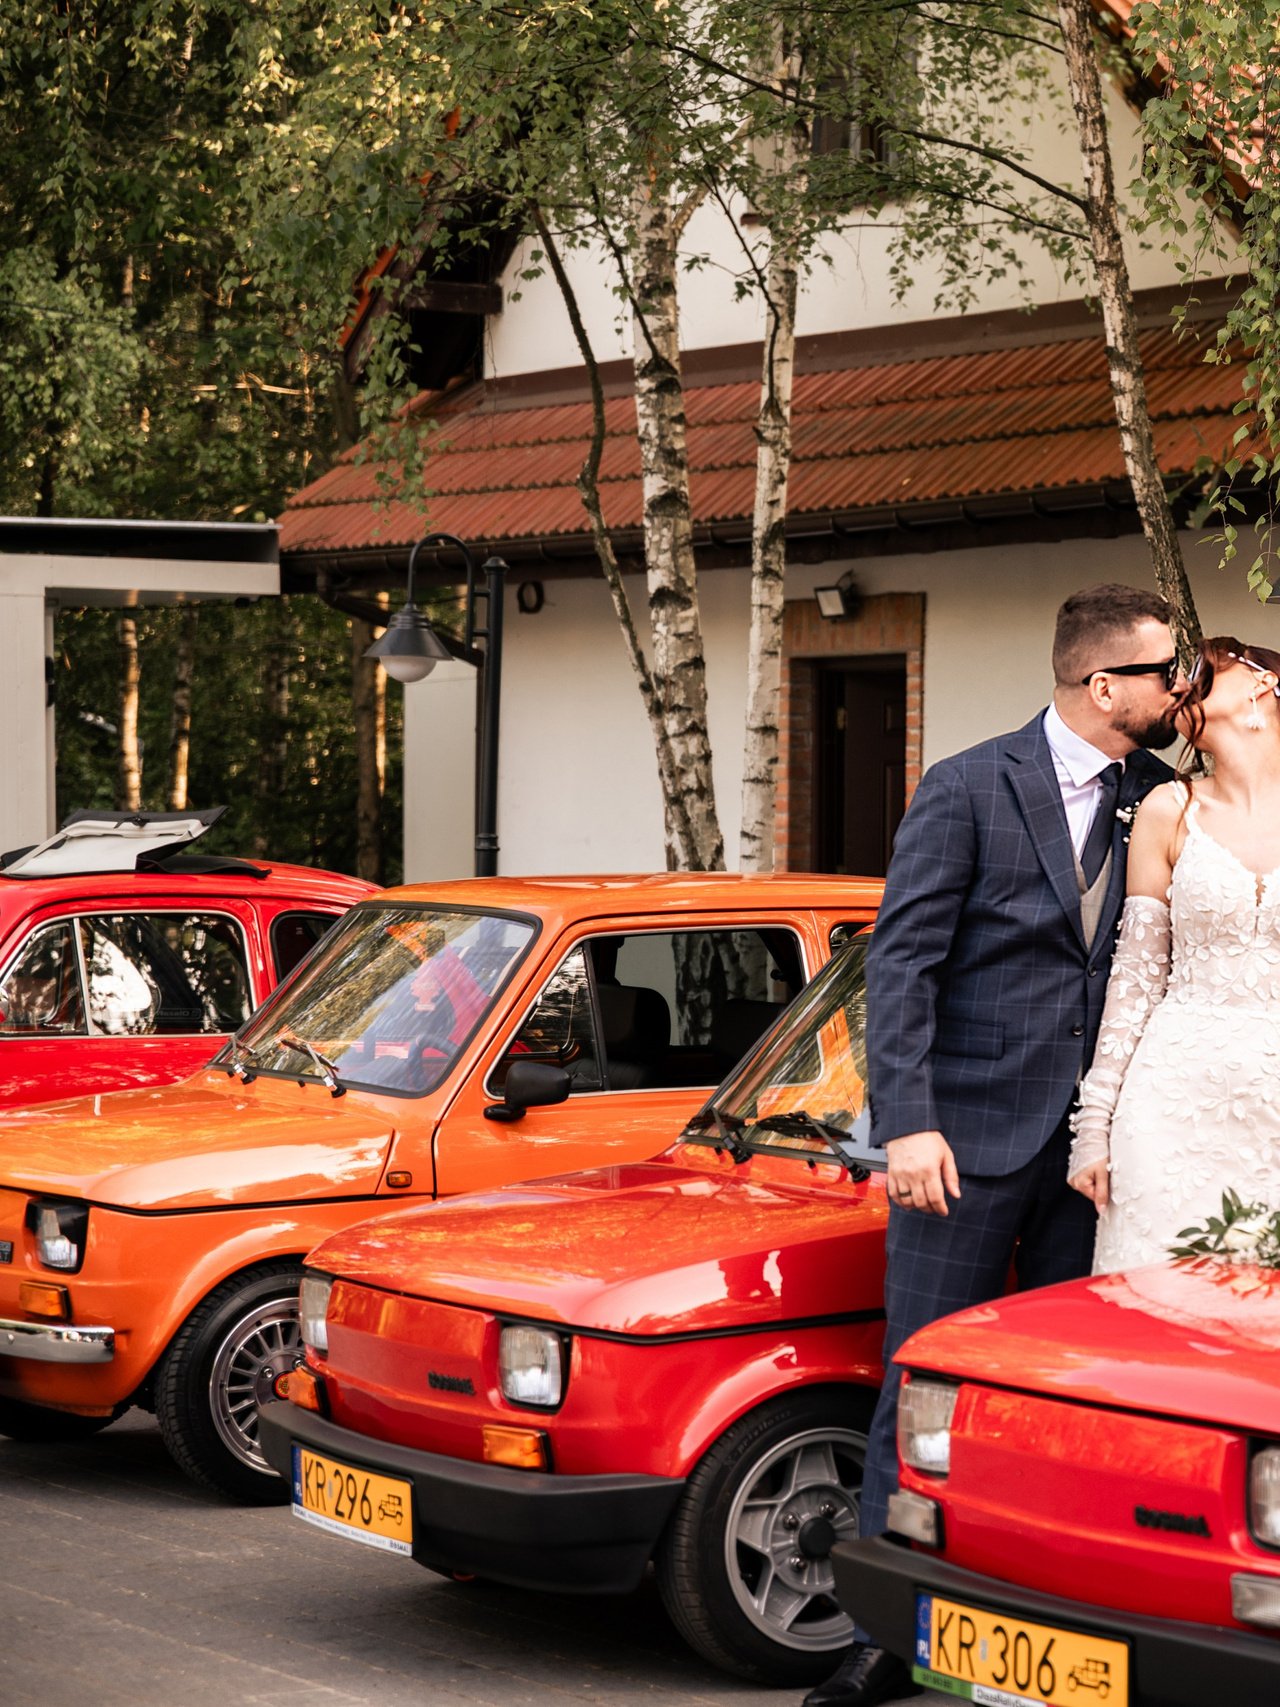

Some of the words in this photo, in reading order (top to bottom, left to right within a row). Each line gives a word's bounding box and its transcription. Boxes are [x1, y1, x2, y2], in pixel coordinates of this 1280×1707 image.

[304, 1456, 327, 1512] KR
[334, 1468, 372, 1526] 296
[917, 1639, 931, 1659] PL
[937, 1608, 977, 1678] KR
[991, 1625, 1056, 1697] 306
